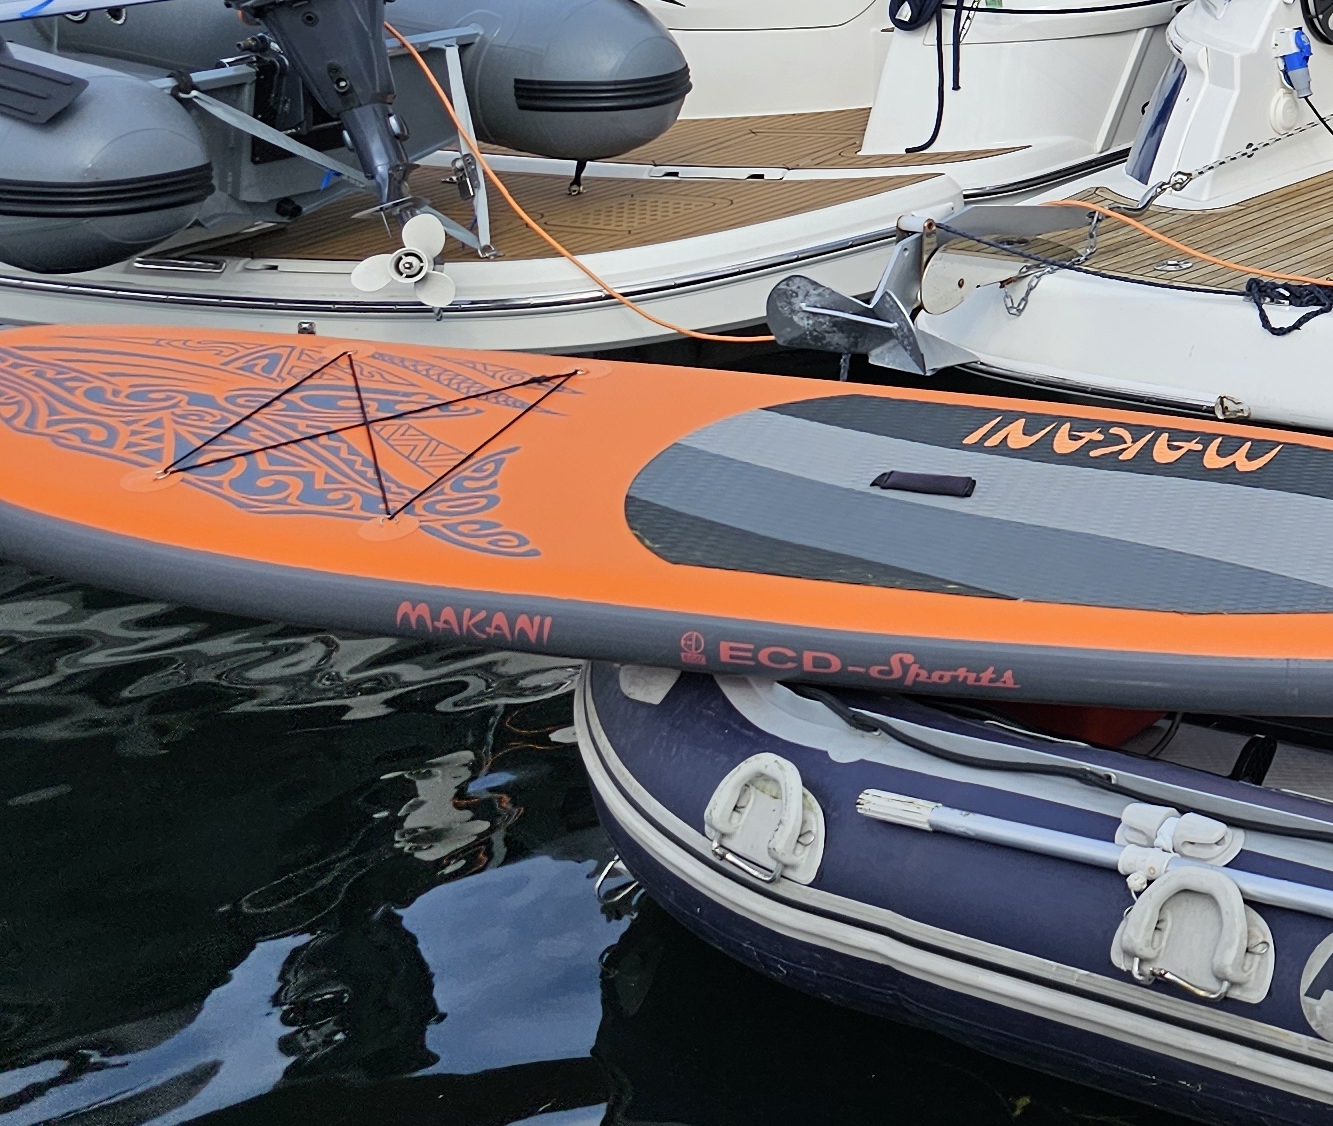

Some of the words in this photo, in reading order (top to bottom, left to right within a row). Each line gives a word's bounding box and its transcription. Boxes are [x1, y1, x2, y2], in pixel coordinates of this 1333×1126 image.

[962, 415, 1284, 472] MAKANI
[396, 600, 552, 646] MAKANI
[719, 640, 1022, 689] ECD-Sports
